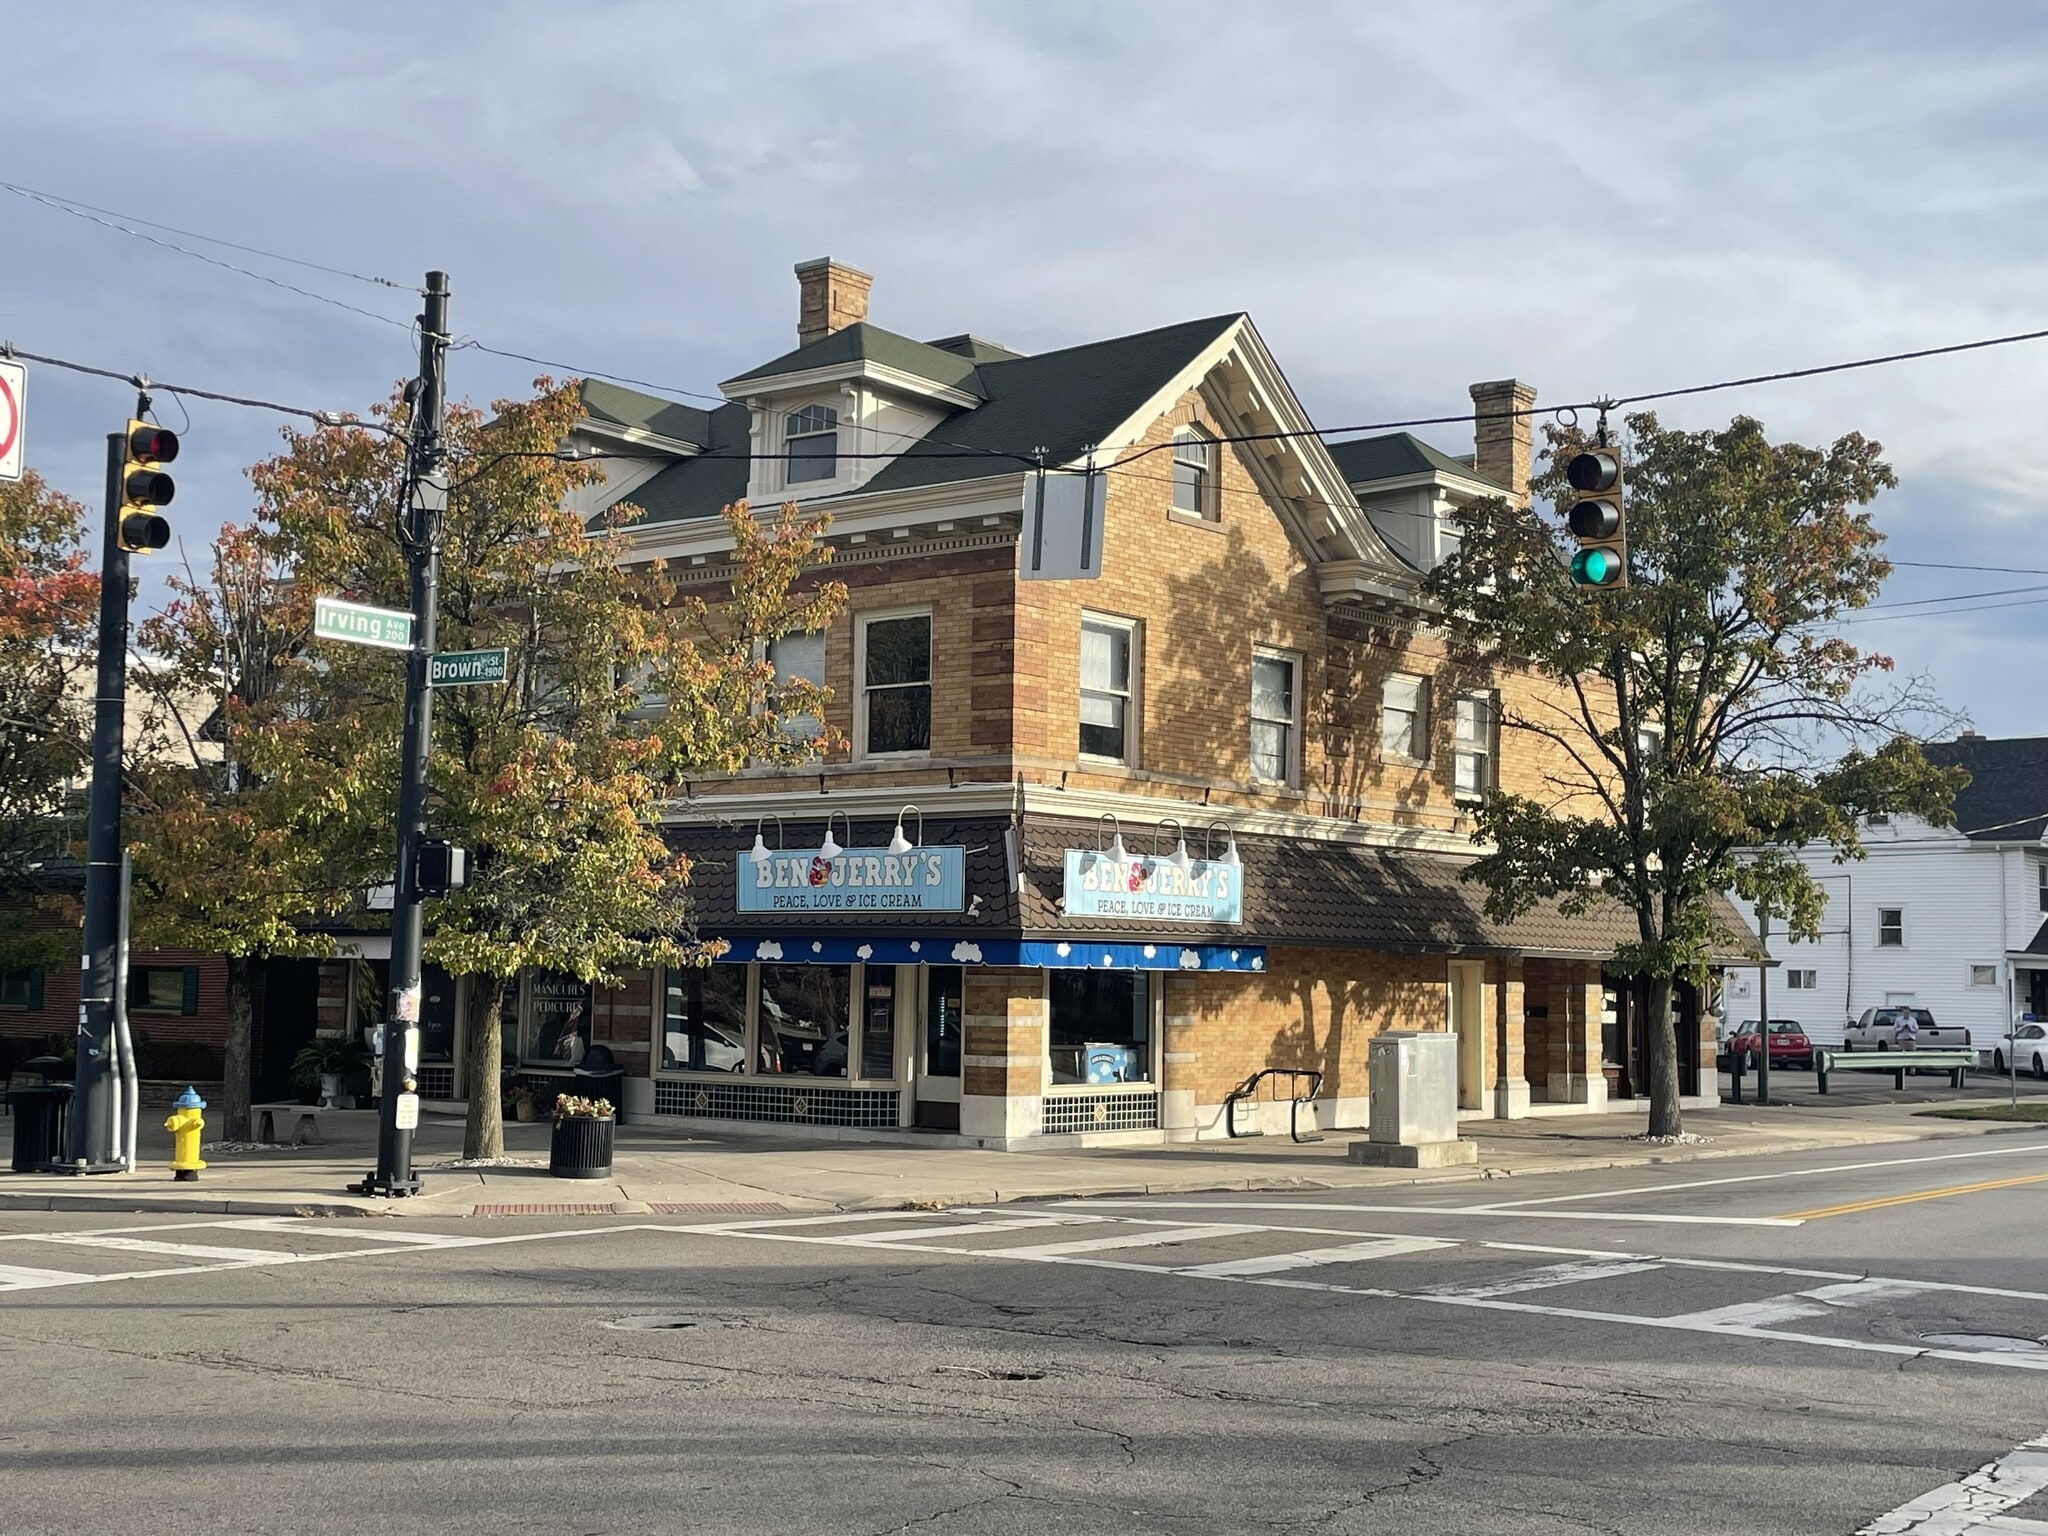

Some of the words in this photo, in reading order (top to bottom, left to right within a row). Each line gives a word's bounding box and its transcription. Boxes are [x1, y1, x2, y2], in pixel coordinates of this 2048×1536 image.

[320, 607, 382, 639] Irving
[386, 619, 405, 631] Ave
[385, 630, 404, 641] 200
[490, 656, 499, 666] St
[432, 659, 482, 679] Brown
[756, 857, 809, 888] BEN
[831, 851, 942, 888] JERRY'S
[1083, 860, 1129, 893] BEN
[1145, 864, 1228, 899] JERRY'S
[773, 895, 809, 909] PEACE,
[813, 895, 842, 907] LOVE
[845, 895, 856, 907] &
[858, 894, 877, 907] ICE
[880, 894, 922, 907] CREAM
[1097, 899, 1128, 915] PEACE,
[1131, 901, 1154, 915] LOVE
[1157, 902, 1166, 915] &
[1167, 902, 1182, 916] ICE
[1184, 903, 1215, 918] CREAM
[533, 983, 586, 996] MANICURES
[533, 1000, 584, 1013] PEDICURES
